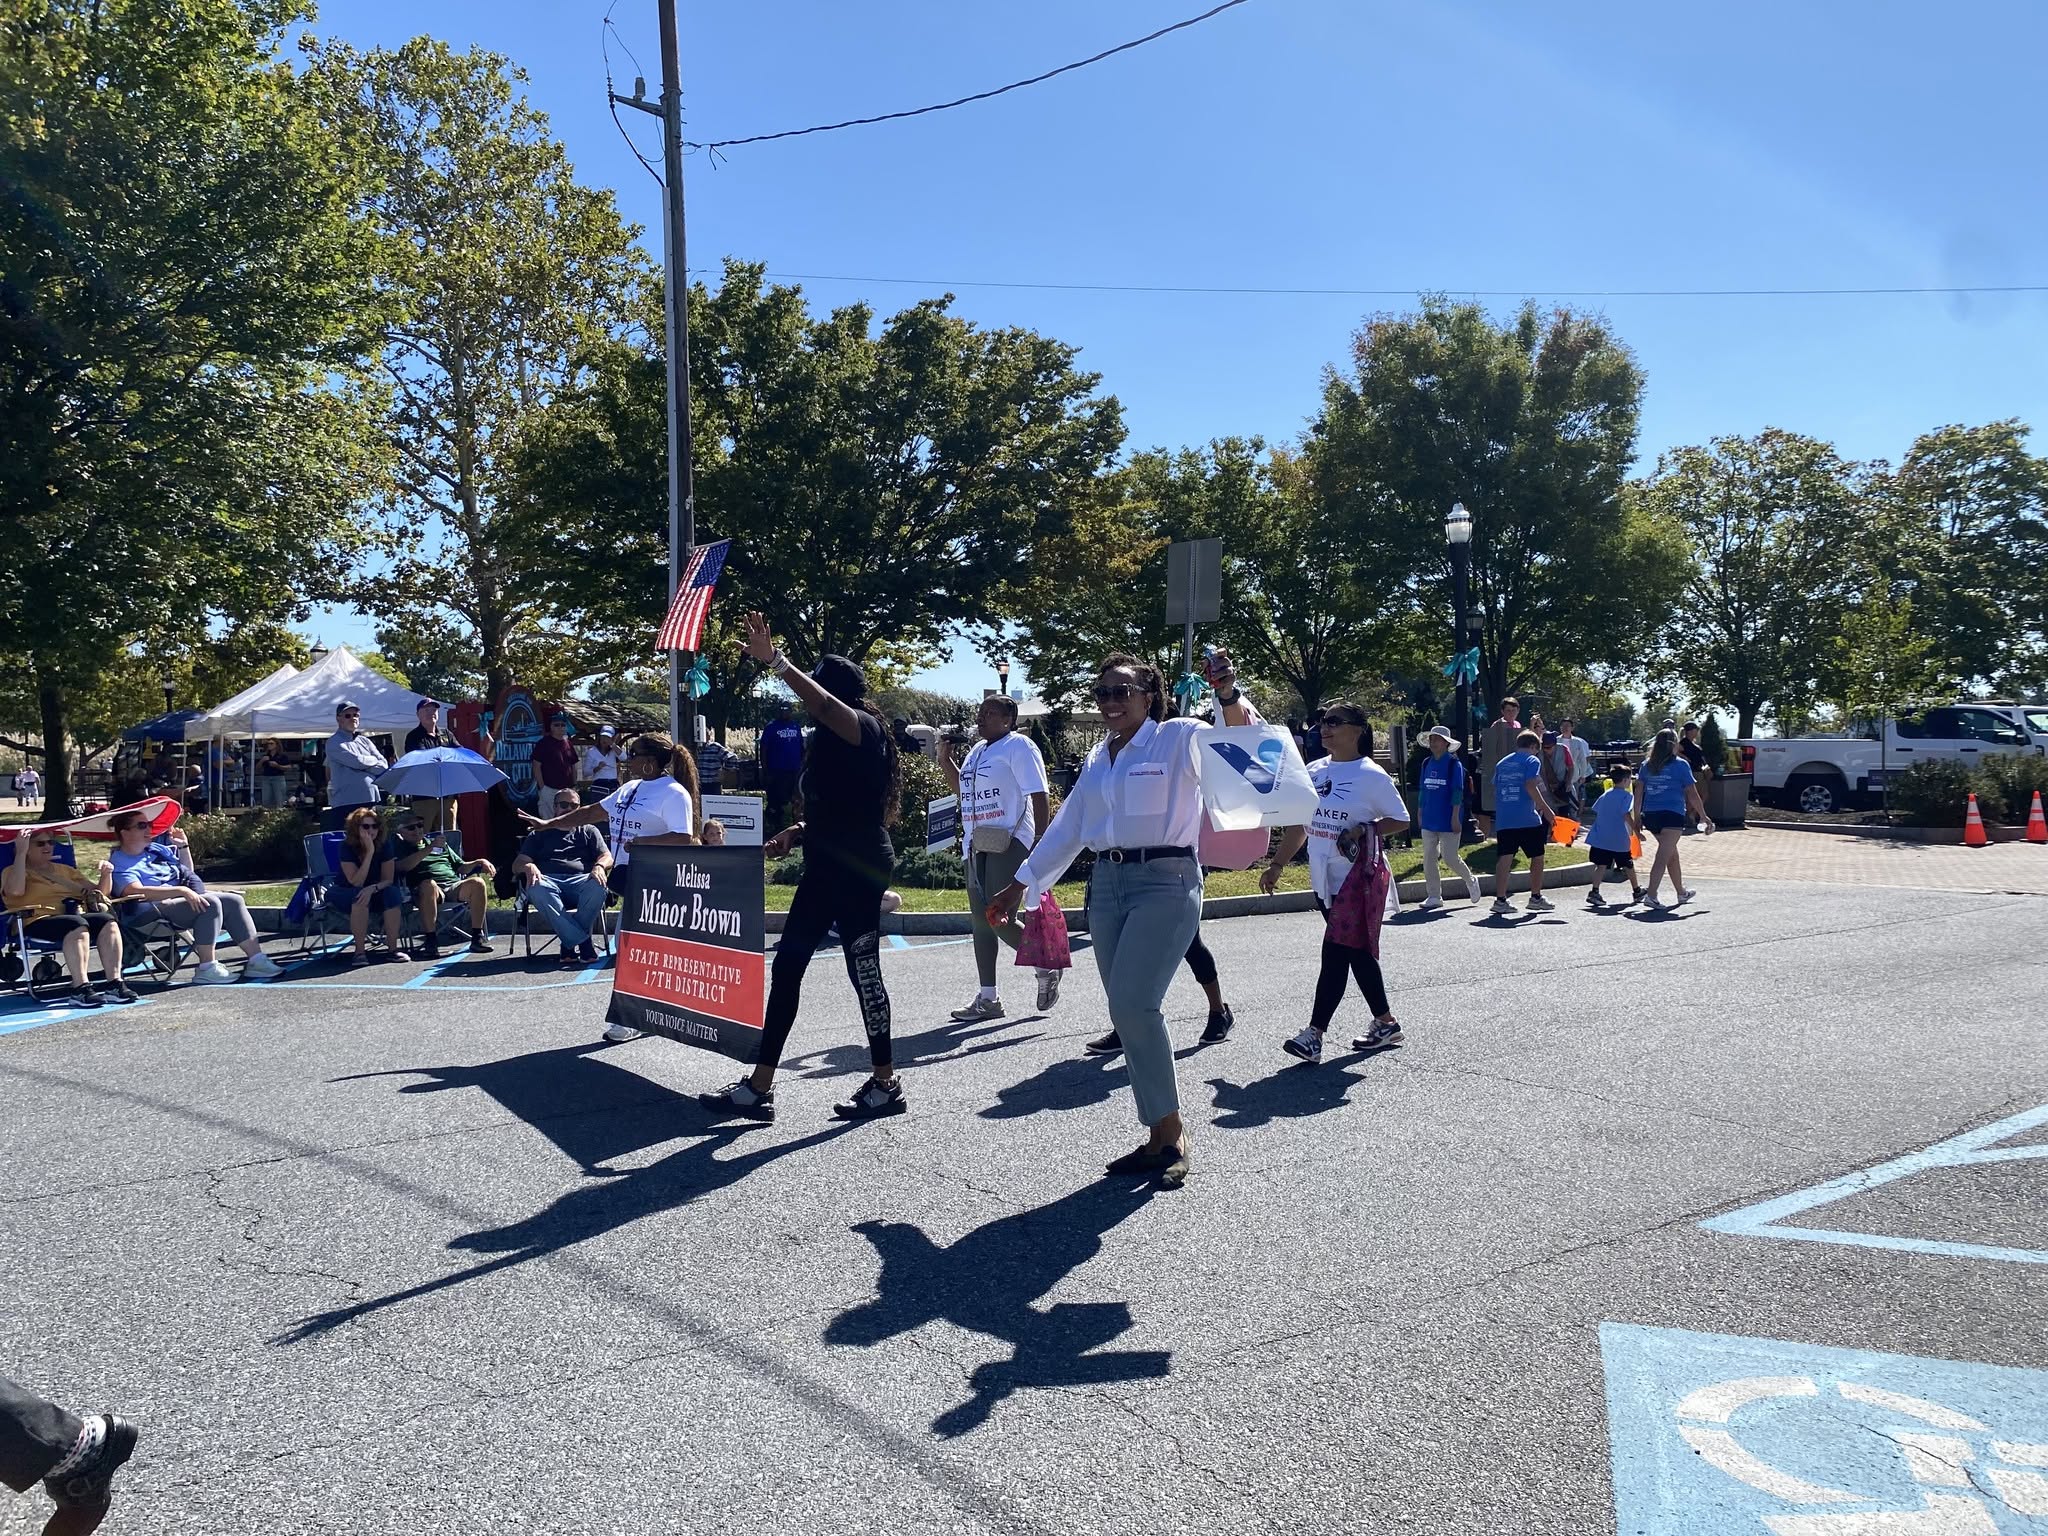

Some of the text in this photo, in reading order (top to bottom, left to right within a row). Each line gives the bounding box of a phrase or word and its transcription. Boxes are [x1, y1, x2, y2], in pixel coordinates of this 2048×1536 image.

[675, 863, 711, 890] Melissa
[638, 888, 741, 937] Minor Brown
[628, 948, 742, 986] STATE REPRESENTATIVE
[644, 969, 726, 1004] 17TH DISTRICT
[855, 953, 889, 1037] EAGLES
[645, 1008, 719, 1043] YOUR VOICE MATTERS
